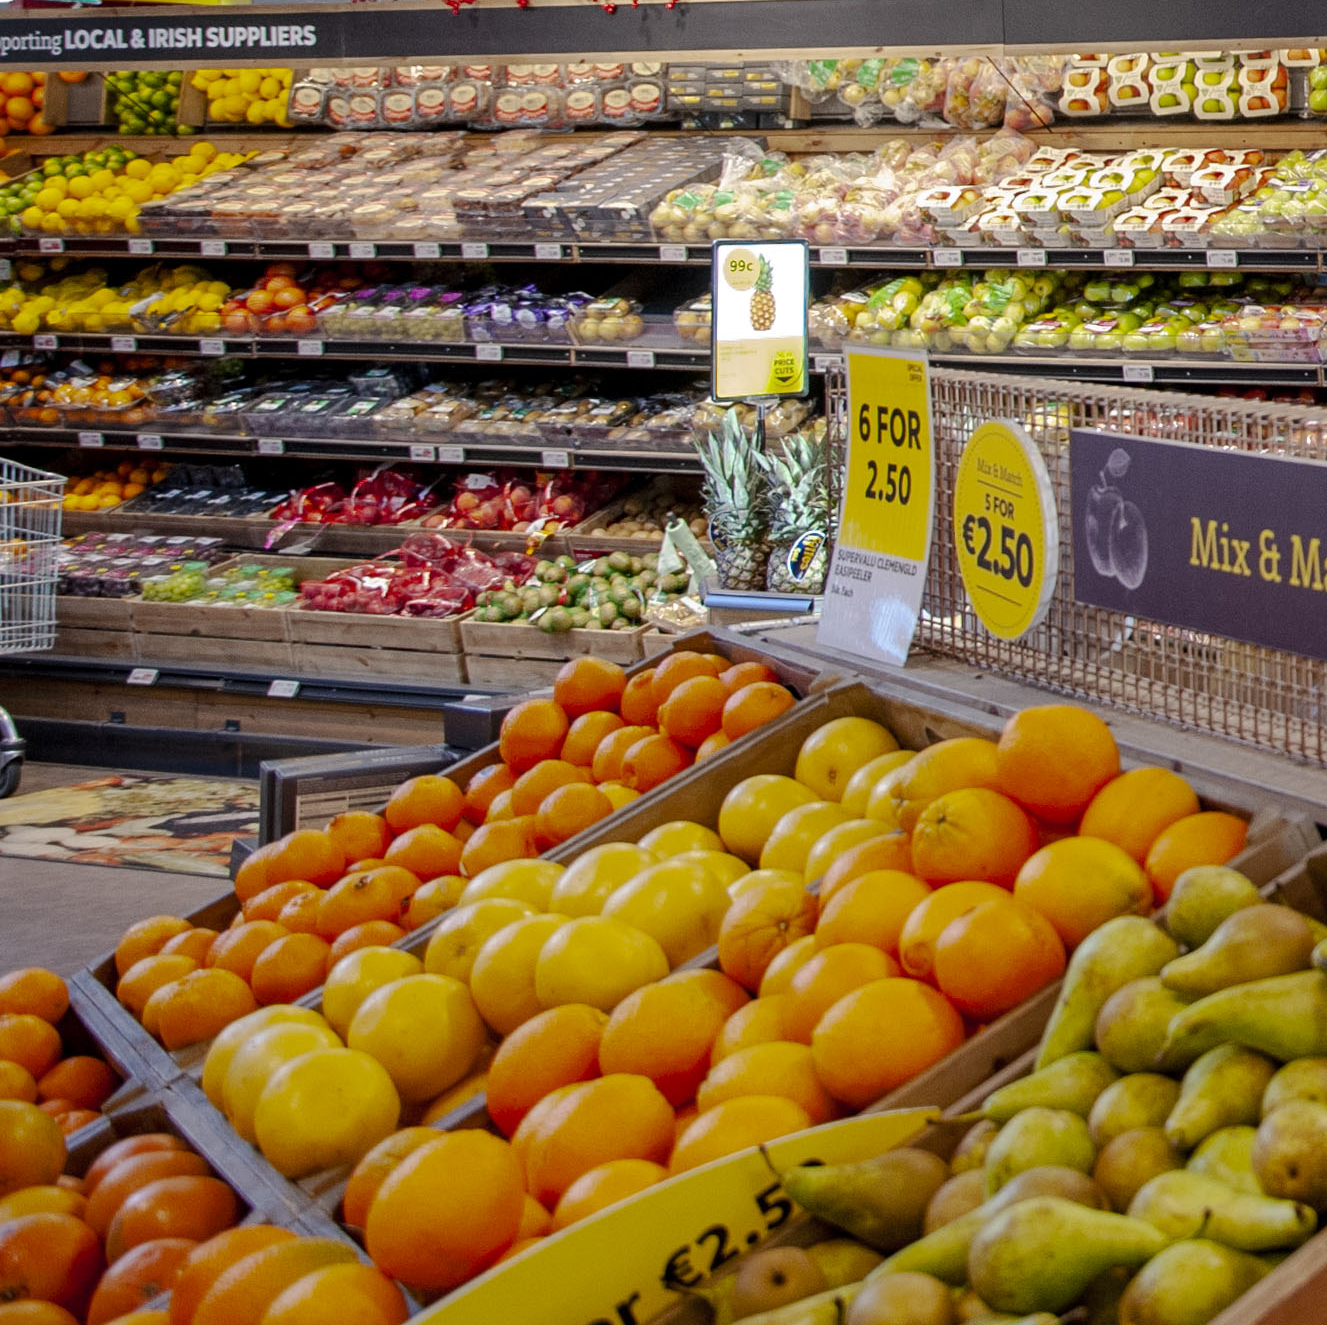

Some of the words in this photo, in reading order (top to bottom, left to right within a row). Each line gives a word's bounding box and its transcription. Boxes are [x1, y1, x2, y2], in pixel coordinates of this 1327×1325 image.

[0, 30, 62, 56] porting
[64, 28, 129, 50] LOCAL
[130, 28, 146, 50] &
[149, 27, 202, 49] IRISH
[206, 25, 317, 48] SUPPLIERS
[729, 259, 753, 273] 99c
[773, 358, 795, 367] PRICE
[774, 367, 794, 375] CUTS
[859, 402, 871, 443] 6
[877, 406, 922, 451] FOR
[864, 459, 912, 506] 2.50
[984, 493, 991, 511] 5
[993, 496, 1015, 521] FOR
[962, 514, 1034, 588] €2.50
[1190, 517, 1251, 578] Mix
[1258, 530, 1282, 584] &
[660, 1158, 826, 1290] €2.5
